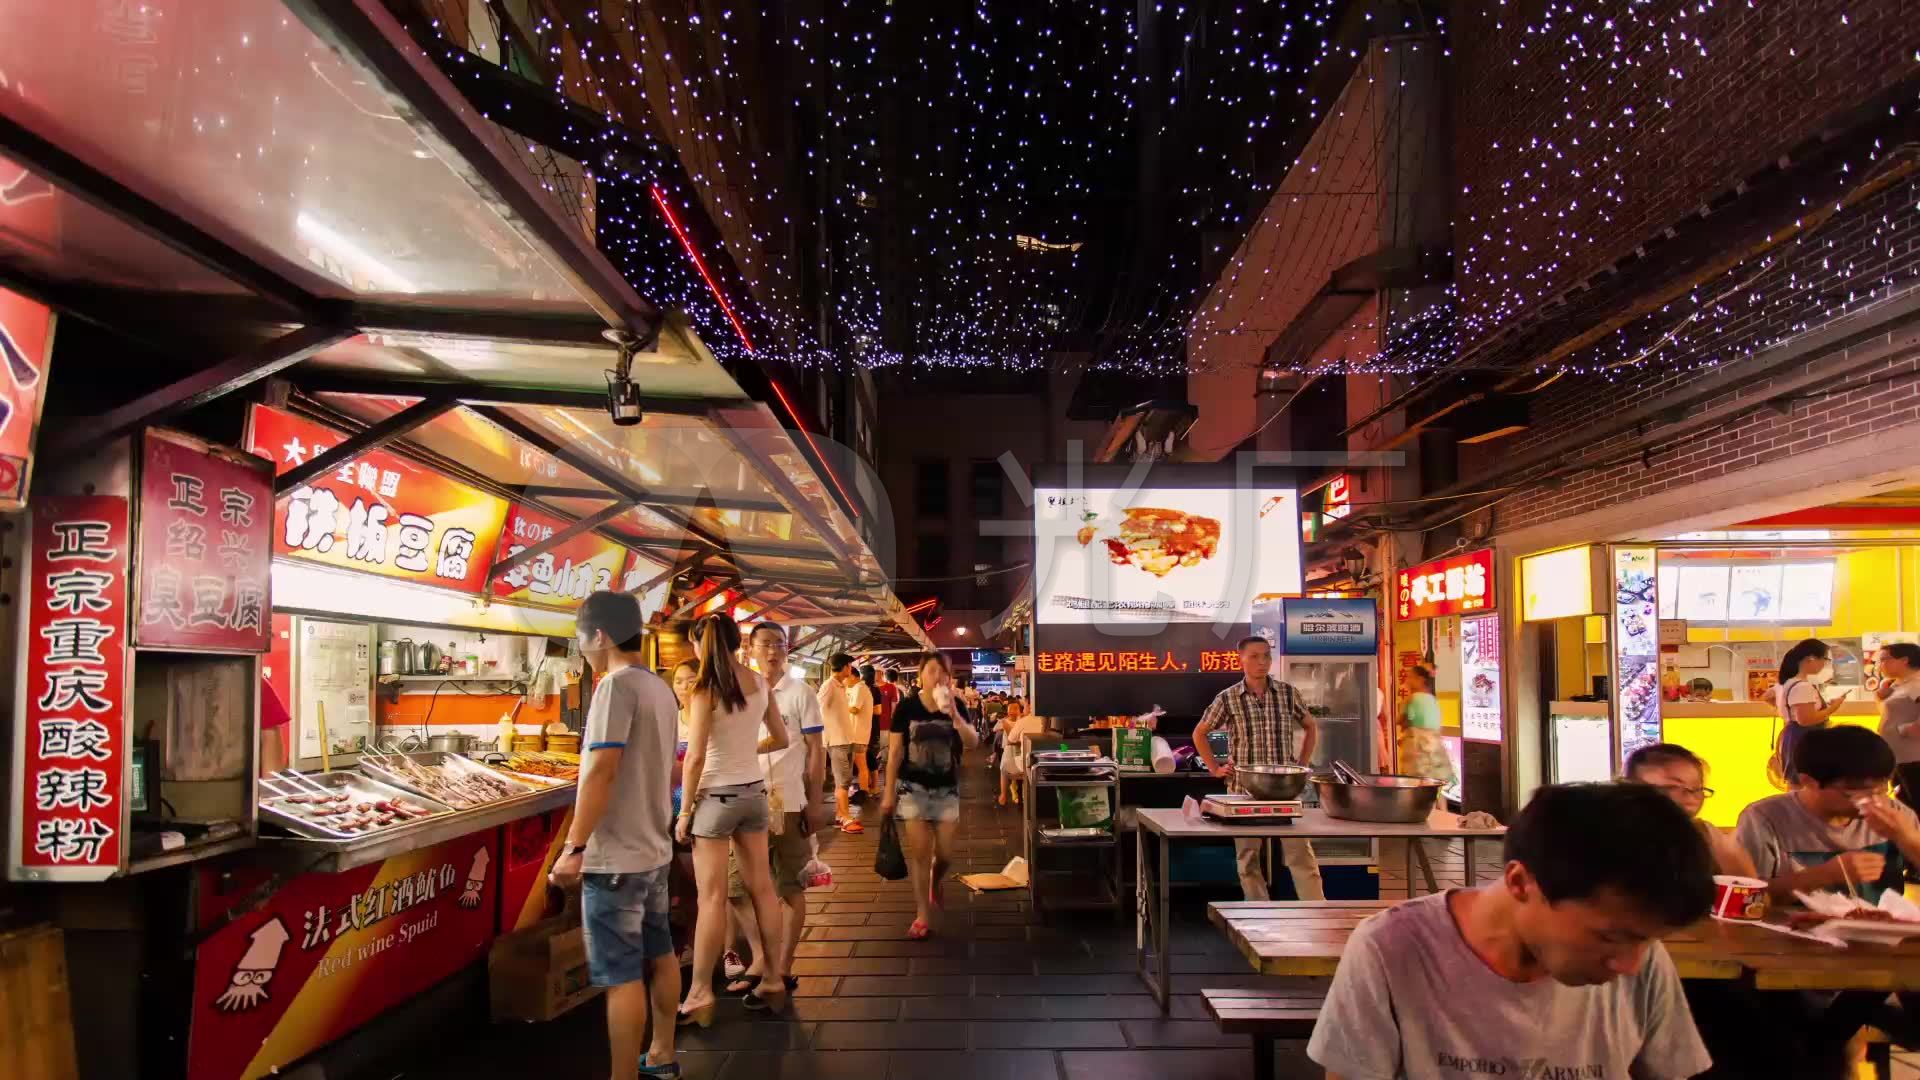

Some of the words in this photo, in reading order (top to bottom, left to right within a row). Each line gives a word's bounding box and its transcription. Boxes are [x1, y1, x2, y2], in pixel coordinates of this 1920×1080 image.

[168, 473, 253, 527] 正宗
[166, 519, 252, 570] 绍兴
[144, 561, 263, 636] 臭豆腐
[36, 521, 117, 863] 正宗重庆酸辣粉
[318, 947, 352, 979] Red
[357, 934, 395, 961] wine
[398, 910, 439, 943] Spuid
